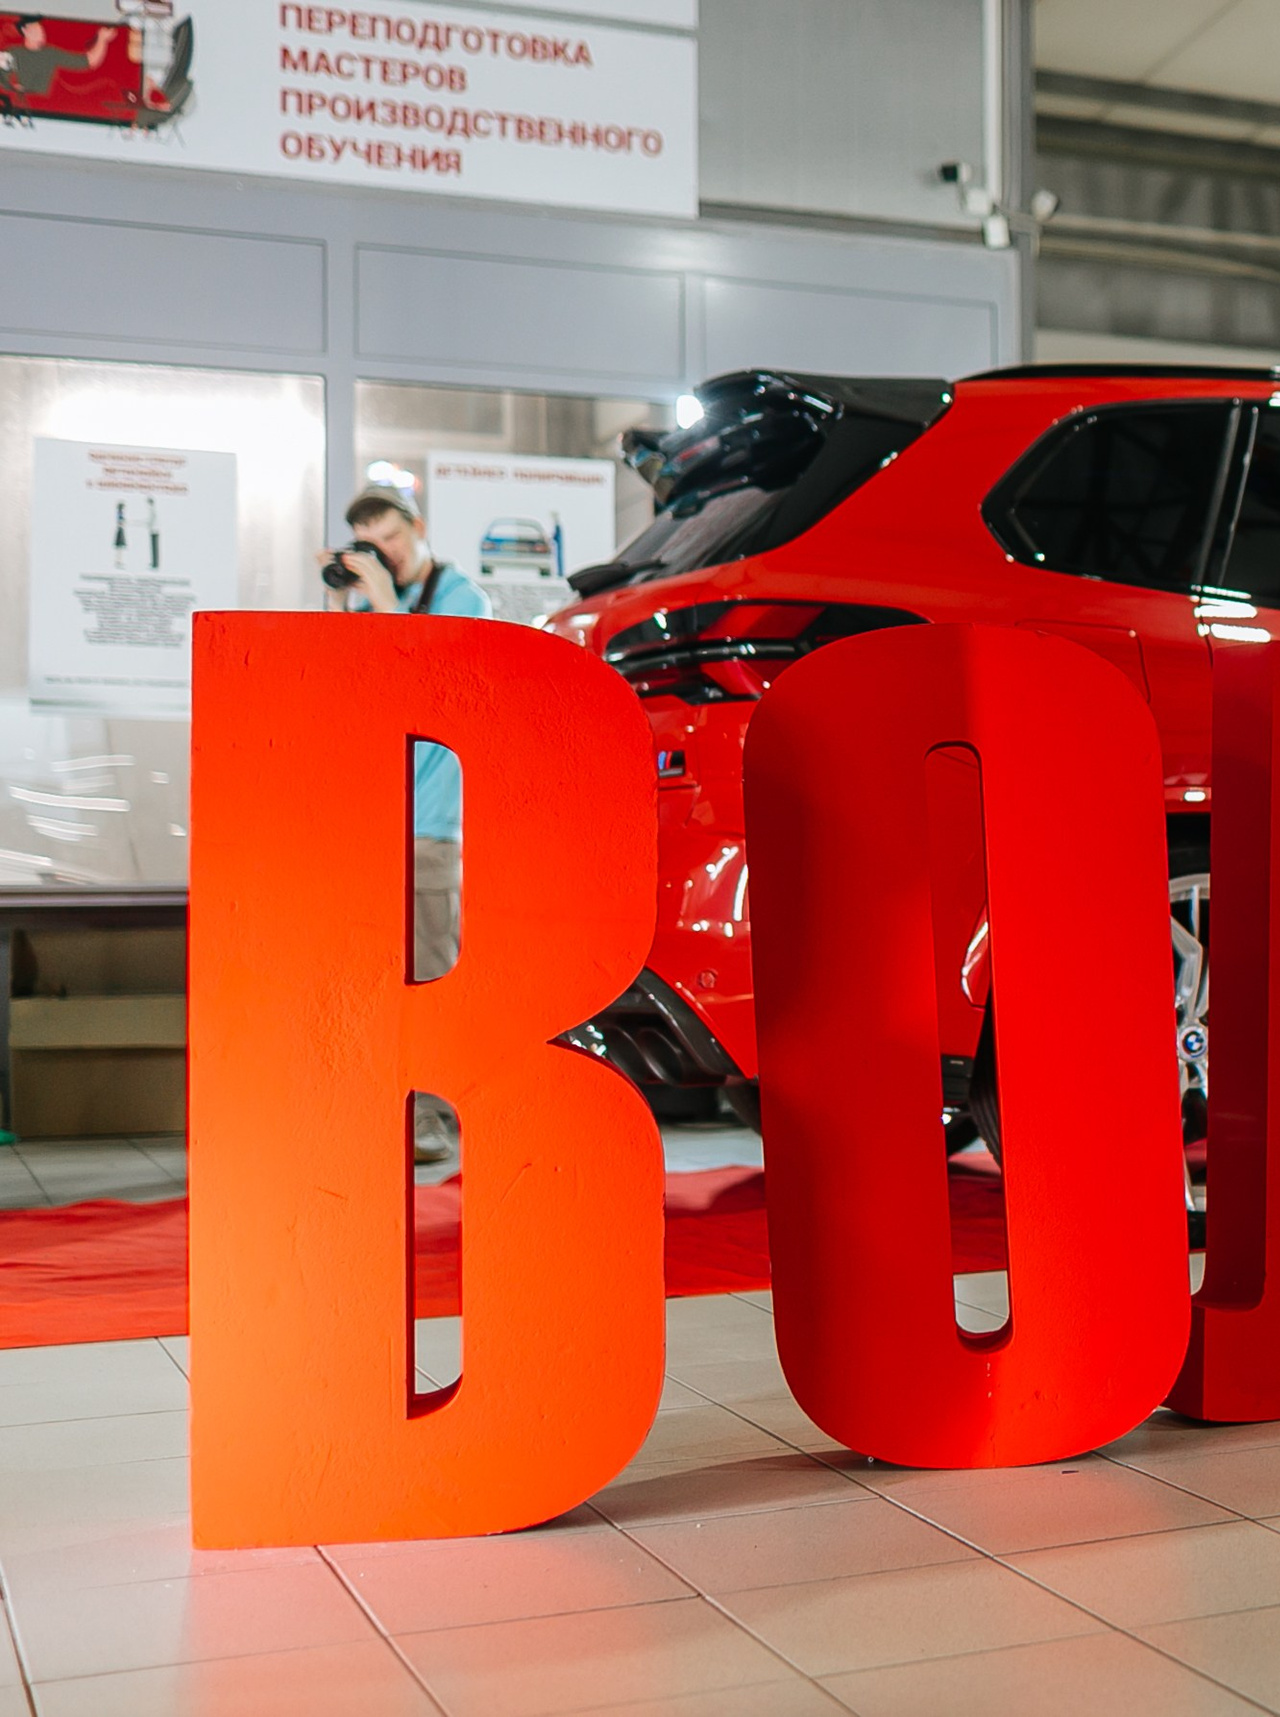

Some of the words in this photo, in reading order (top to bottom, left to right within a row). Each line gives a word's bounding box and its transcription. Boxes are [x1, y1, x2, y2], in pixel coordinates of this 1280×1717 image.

[279, 4, 591, 66] ПЕРЕПОДГОТОВКА
[279, 46, 467, 92] МАСТЕРОВ
[279, 88, 662, 155] ПРОИЗВОДСТВЕННОГО
[279, 132, 461, 175] ОБУЧЕНИЯ
